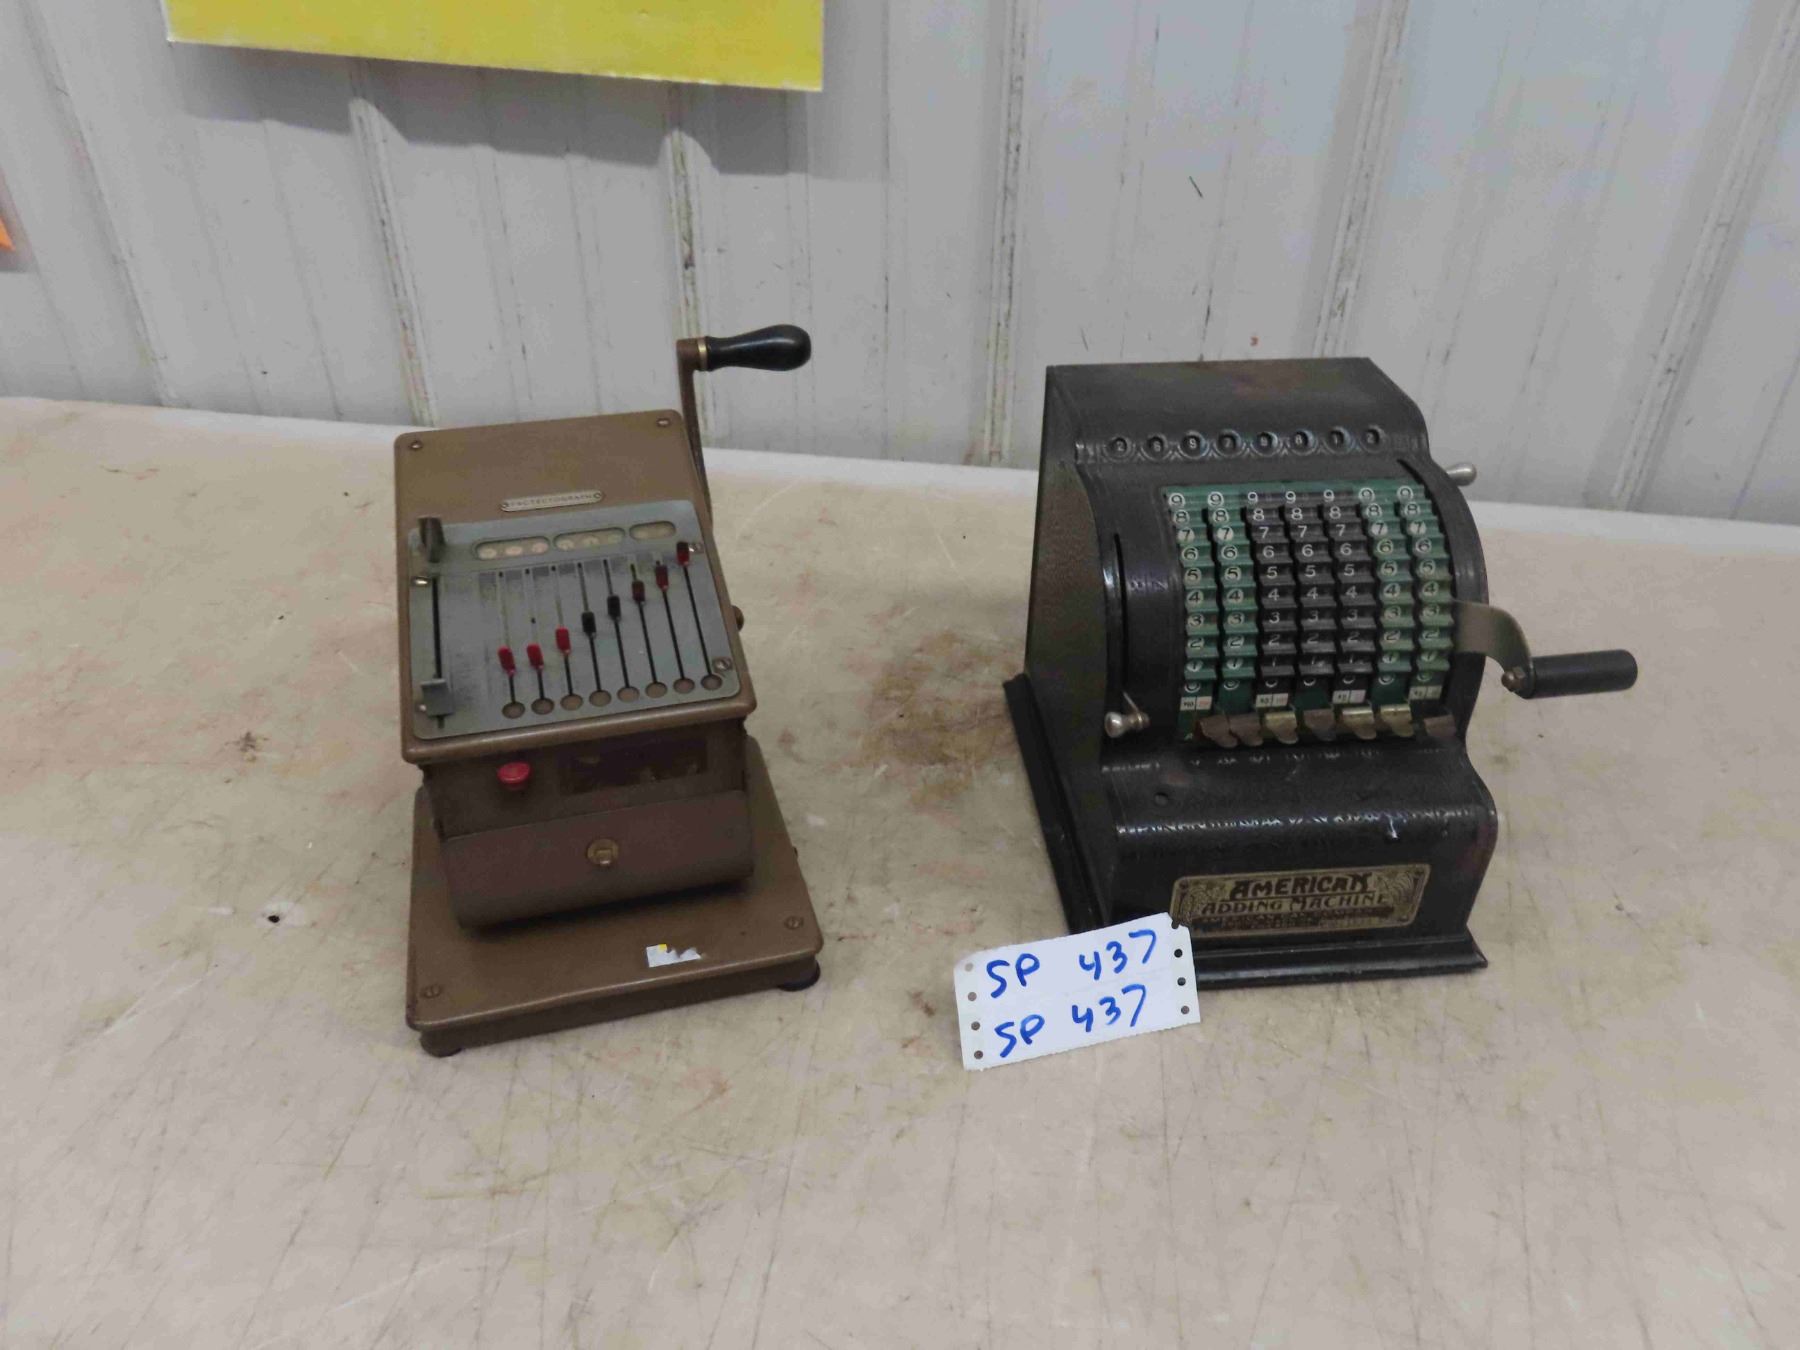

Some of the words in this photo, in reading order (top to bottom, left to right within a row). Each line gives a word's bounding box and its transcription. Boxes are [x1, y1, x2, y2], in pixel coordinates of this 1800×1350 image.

[1247, 491, 1258, 503] 9
[1285, 491, 1296, 503] 9
[1323, 490, 1334, 502] 9
[1253, 509, 1264, 521] 8
[1291, 508, 1302, 520] 8
[1329, 507, 1341, 519] 8
[1259, 526, 1270, 538] 7
[1297, 525, 1308, 537] 7
[1335, 524, 1347, 536] 7
[1263, 546, 1274, 558] 6
[1302, 544, 1313, 556] 6
[1341, 543, 1352, 555] 6
[1266, 566, 1278, 578] 5
[1305, 565, 1316, 577] 5
[1344, 564, 1355, 576] 5
[1268, 588, 1279, 600] 4
[1307, 587, 1318, 599] 4
[1346, 585, 1357, 597] 4
[1269, 611, 1280, 623] 3
[1308, 610, 1319, 622] 3
[1347, 609, 1358, 621] 3
[1268, 634, 1279, 645] 2
[1307, 633, 1318, 644] 2
[1348, 631, 1359, 642] 2
[1229, 872, 1373, 899] AMERICAN
[1200, 900, 1282, 915] ADDING
[1289, 893, 1392, 911] MACHINE
[986, 952, 1041, 998] SP
[1078, 928, 1157, 981] 437
[994, 1013, 1046, 1058] SP
[1071, 983, 1147, 1033] 437
